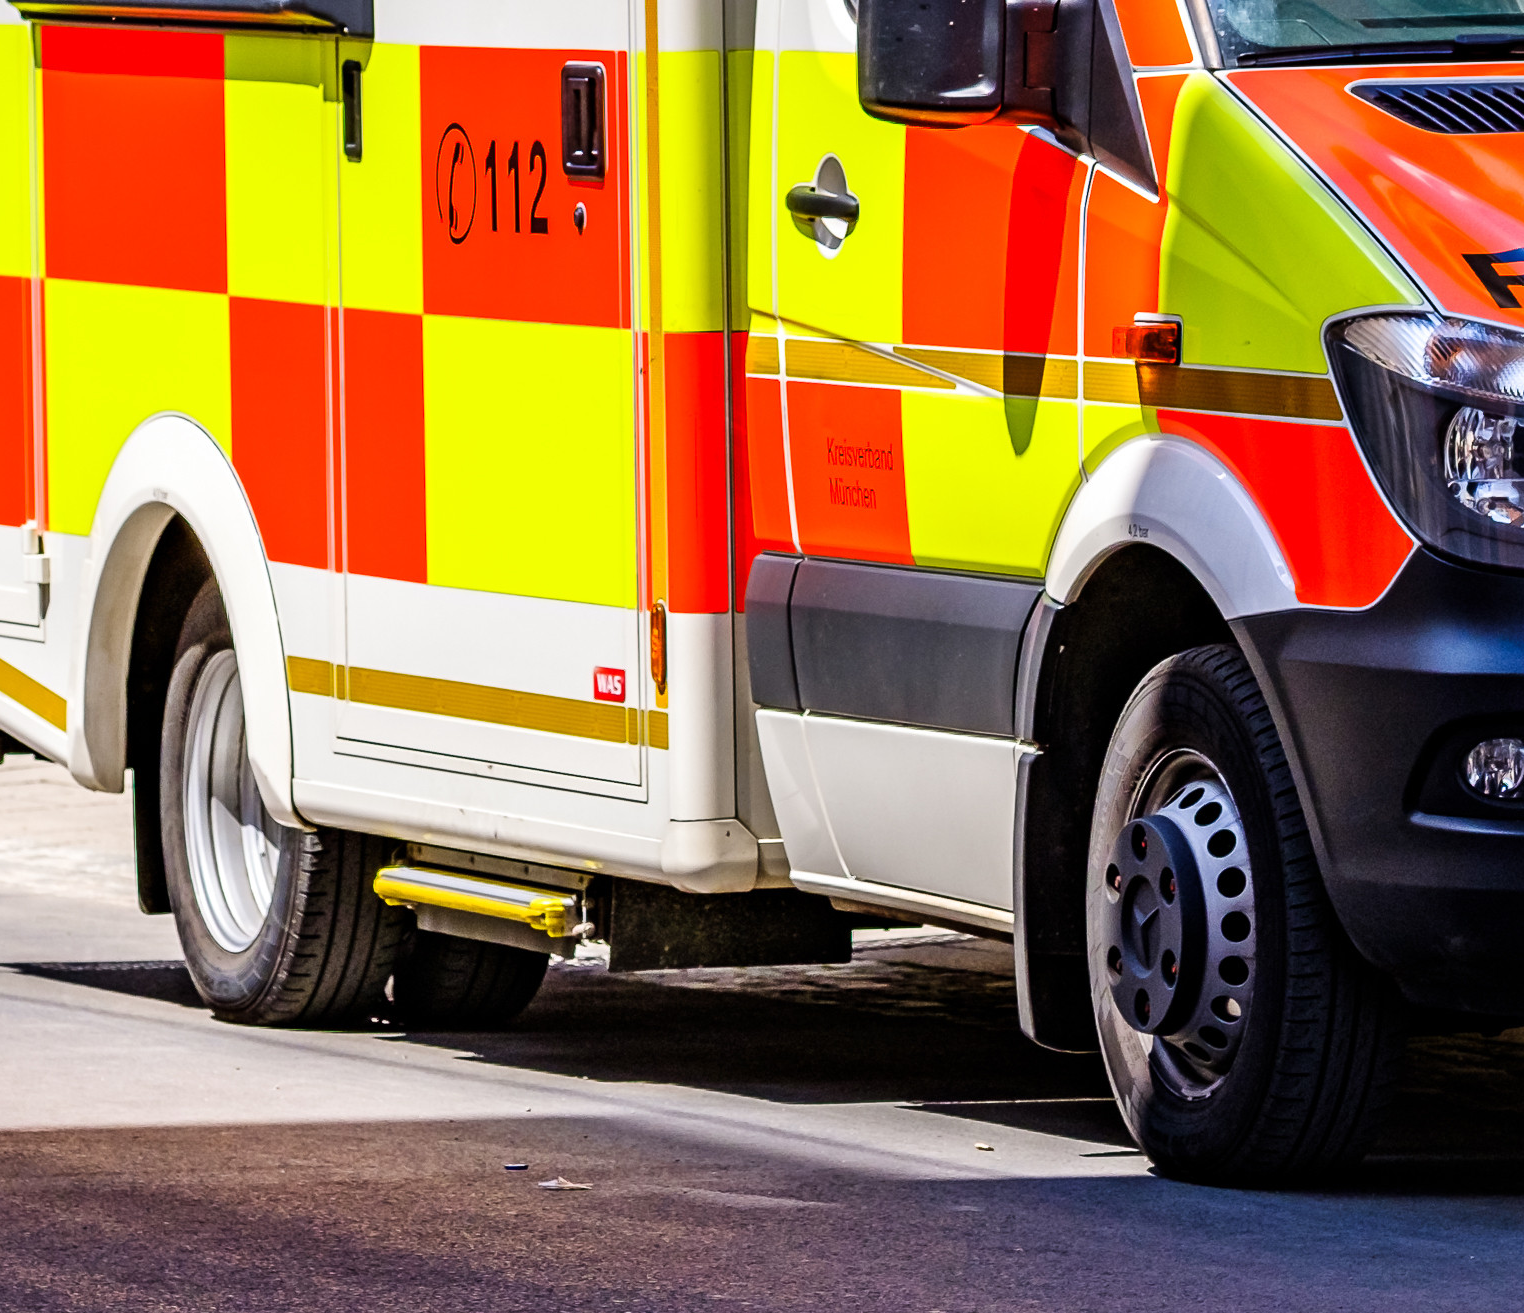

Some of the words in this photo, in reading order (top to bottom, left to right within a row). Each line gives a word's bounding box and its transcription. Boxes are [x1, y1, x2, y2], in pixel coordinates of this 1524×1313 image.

[484, 139, 550, 235] 112
[827, 437, 894, 471] Kreisverband
[829, 477, 877, 509] München
[596, 673, 623, 696] WAS
